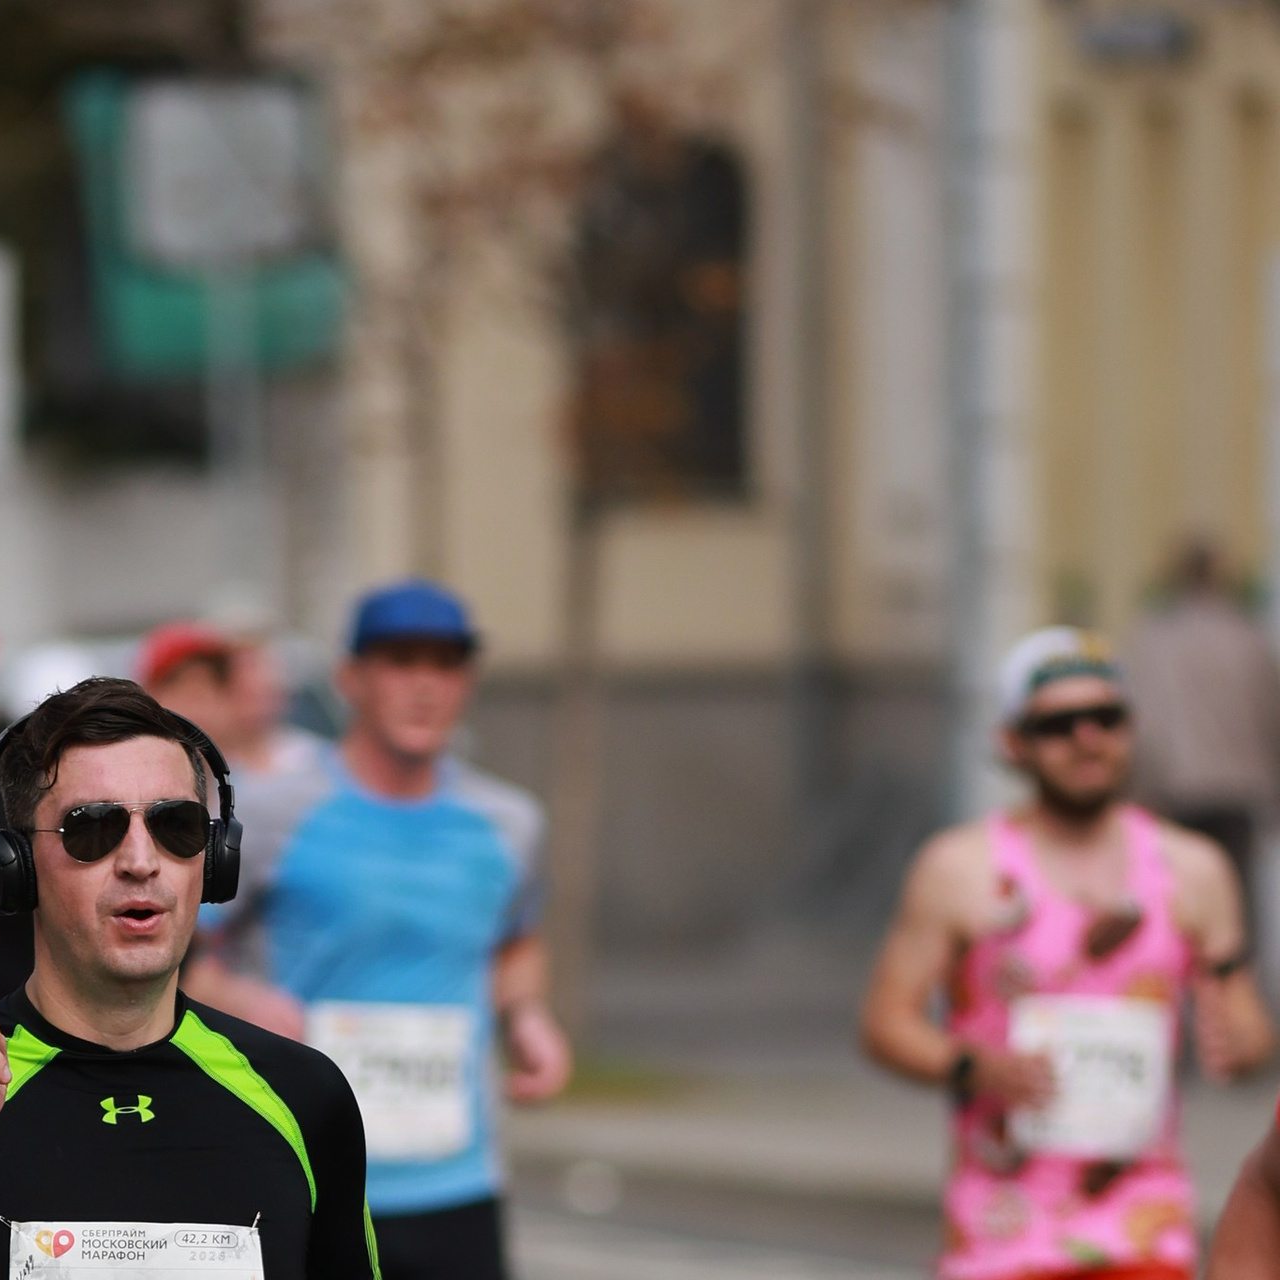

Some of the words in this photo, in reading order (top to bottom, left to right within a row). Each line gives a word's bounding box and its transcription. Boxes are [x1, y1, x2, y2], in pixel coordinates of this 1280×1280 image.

[81, 1229, 146, 1238] СБЕРПРАЙМ
[181, 1233, 208, 1245] 42,2
[81, 1238, 168, 1250] МОСКОВСКИЙ
[81, 1250, 146, 1261] МАРАФОН
